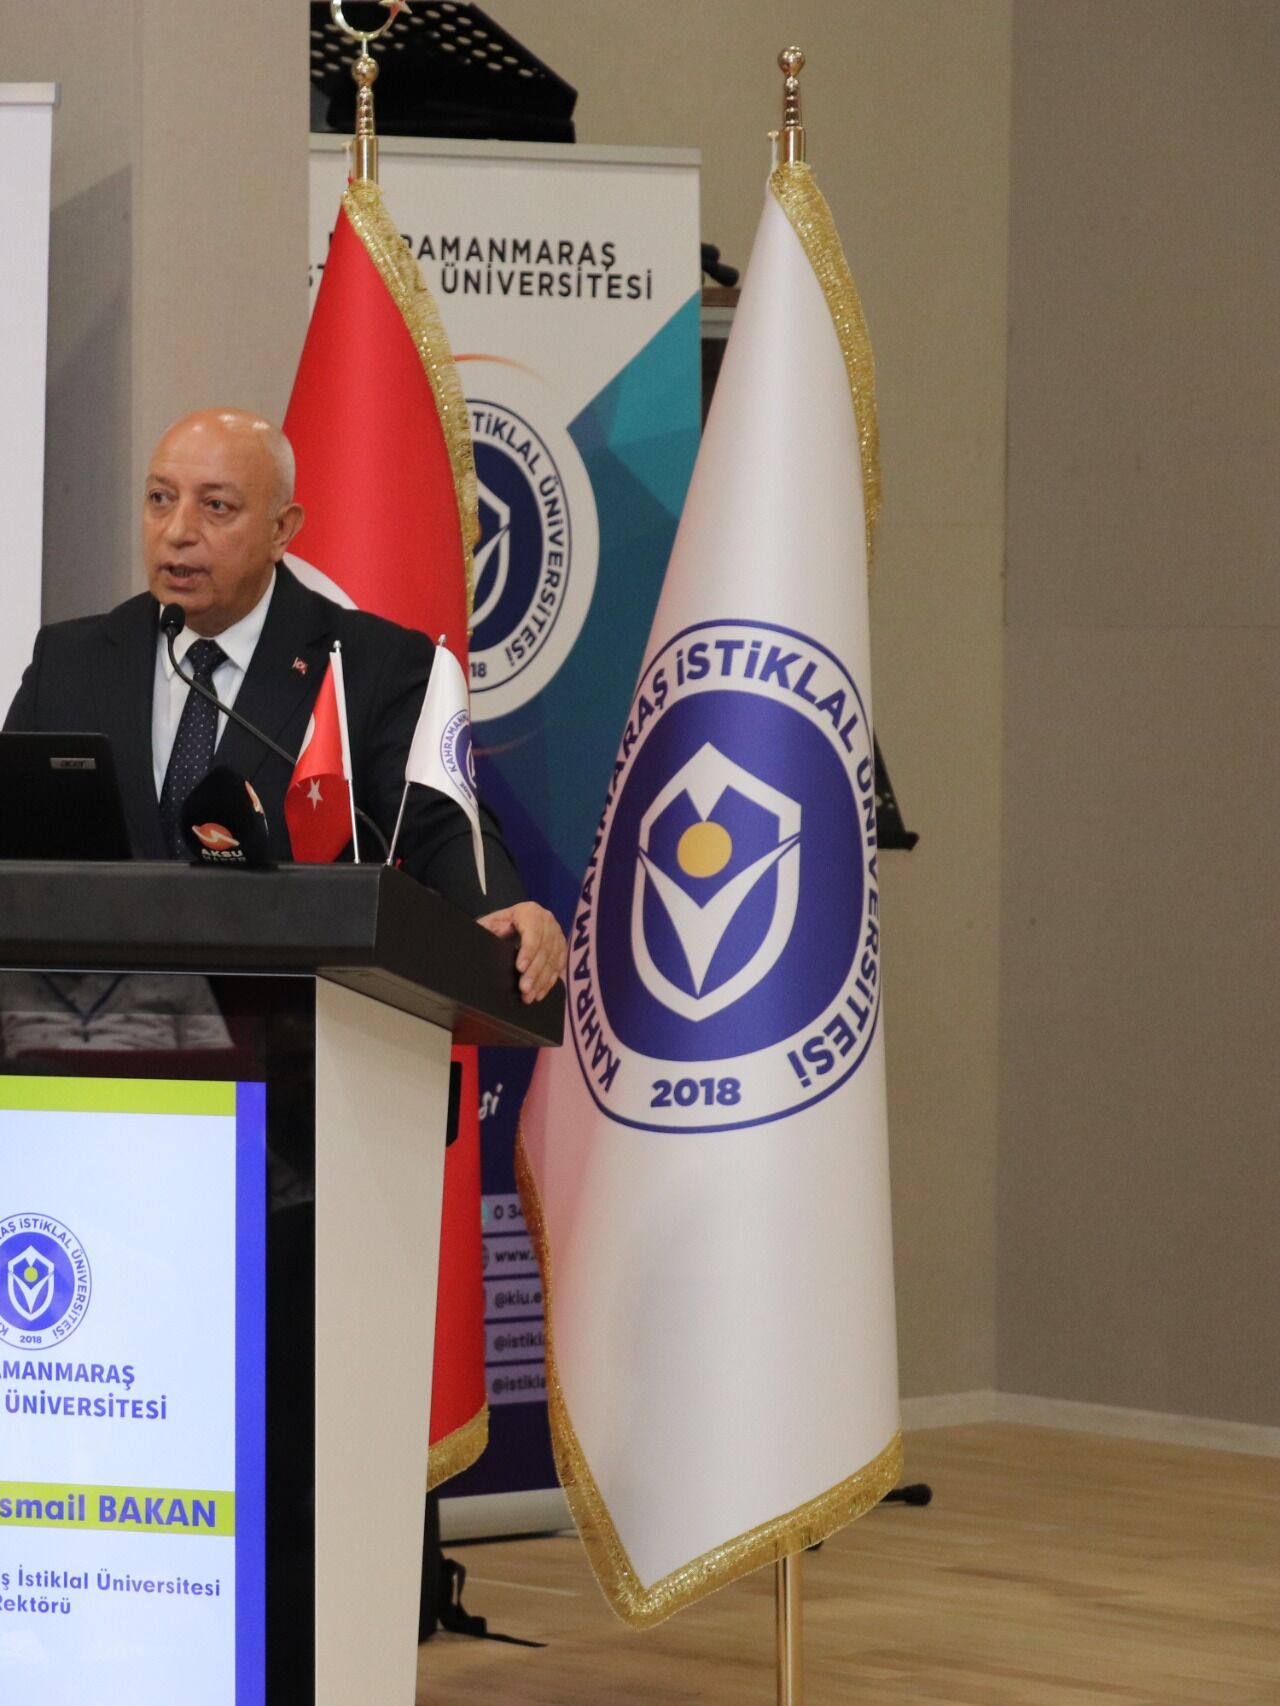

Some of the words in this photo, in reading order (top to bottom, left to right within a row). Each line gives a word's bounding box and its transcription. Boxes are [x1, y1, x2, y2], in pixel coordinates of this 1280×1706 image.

[329, 233, 616, 271] AMANMARAŞ
[440, 261, 652, 300] ÜNİVERSİTESİ
[472, 411, 541, 475] TİKLAL
[505, 474, 565, 667] ÜNİVERSİTESİ
[470, 661, 487, 678] 18
[676, 638, 858, 753] İSTİKLAL
[201, 848, 243, 858] AKSU
[649, 1076, 743, 1109] 2018
[19, 1217, 72, 1249] İSTİKLAL
[51, 1248, 88, 1339] ÜNİVERSİTESİ
[19, 1335, 42, 1344] 2018
[5, 1389, 167, 1420] ÜNİVERSİTESİ
[98, 1496, 216, 1528] BAKAN
[17, 1564, 89, 1590] İstiklal
[97, 1569, 221, 1597] Üniversitesi
